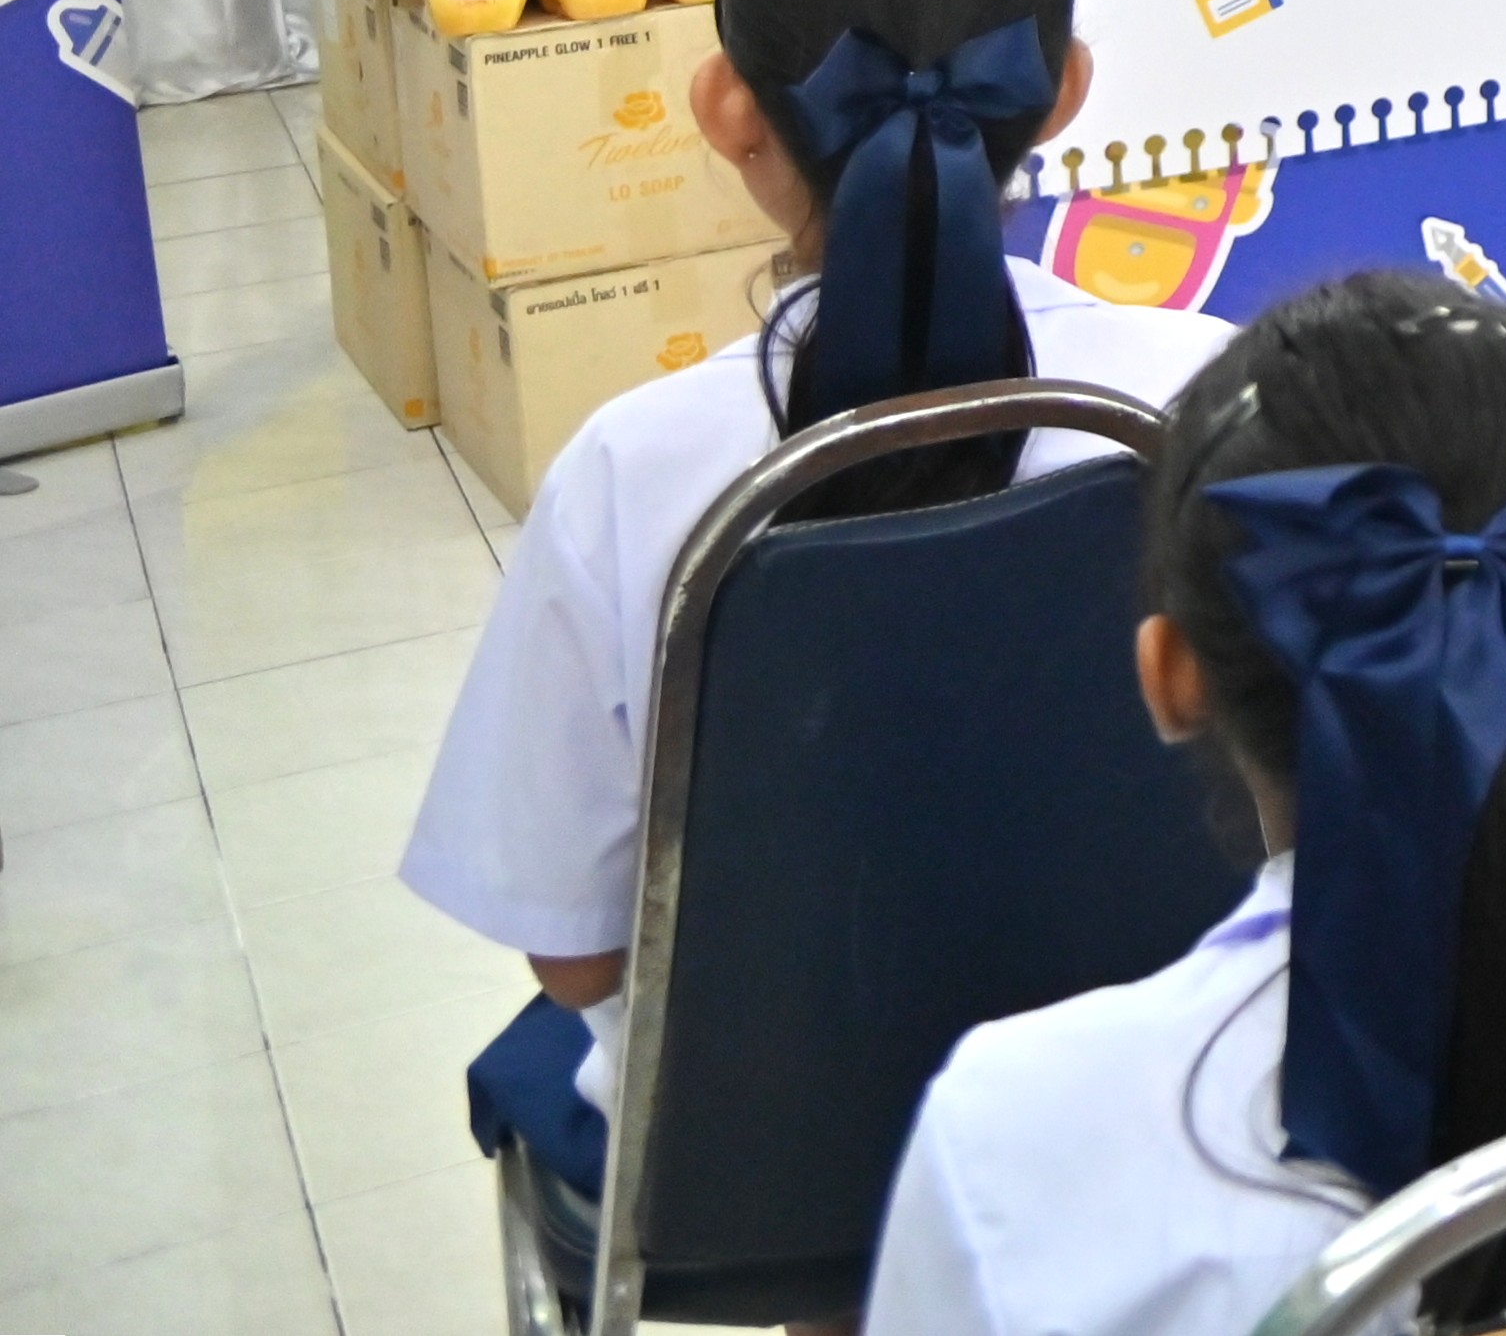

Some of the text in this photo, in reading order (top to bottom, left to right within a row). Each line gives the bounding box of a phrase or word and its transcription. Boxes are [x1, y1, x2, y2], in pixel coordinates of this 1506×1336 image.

[484, 31, 650, 66] PINEAPPLE GLOW 1 FREE 1
[639, 175, 685, 198] SOAP
